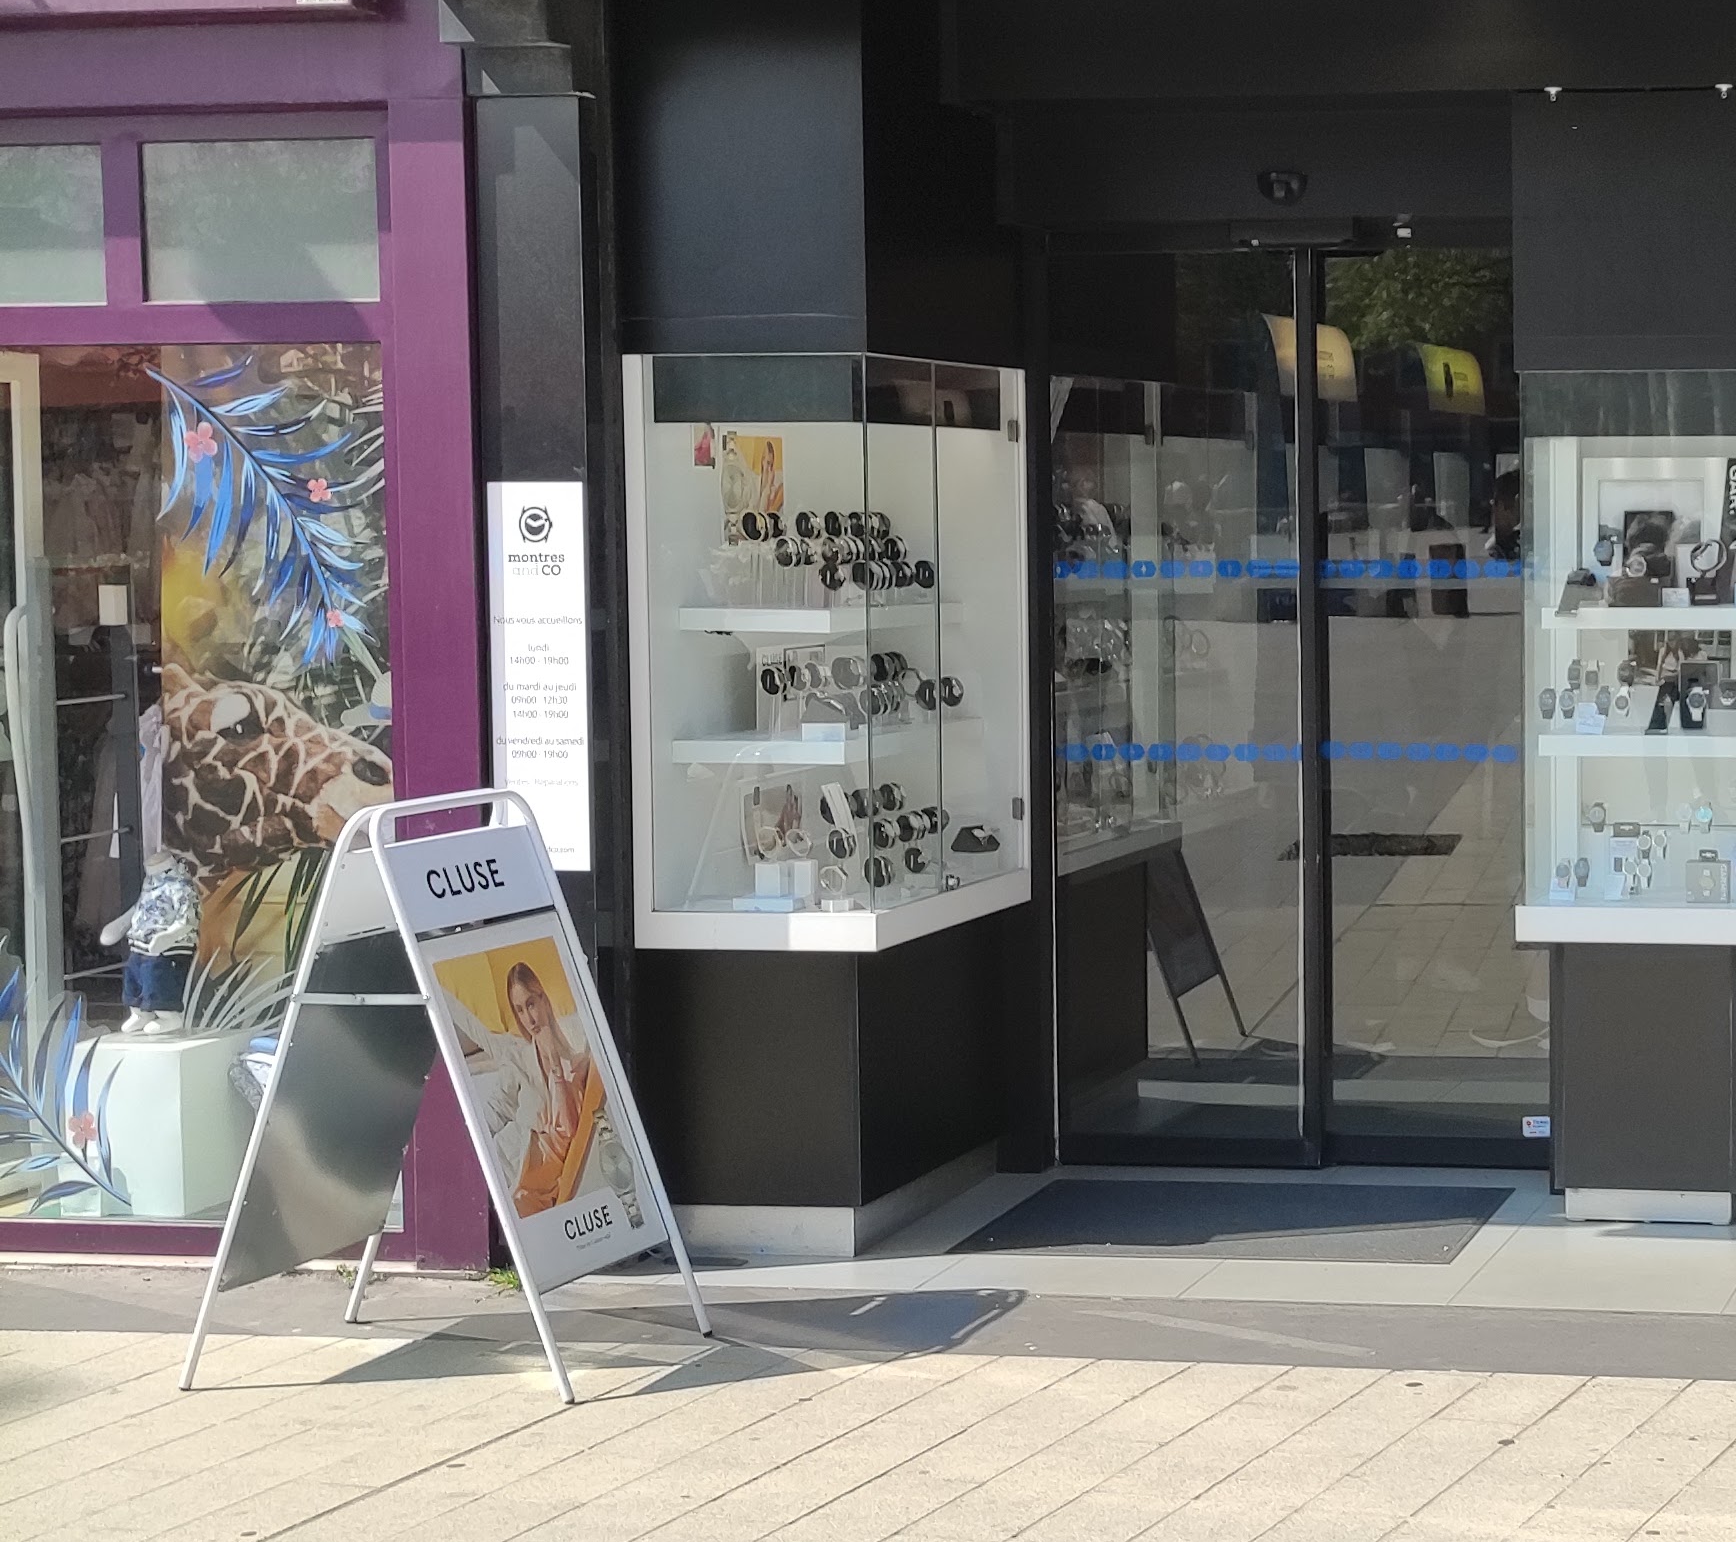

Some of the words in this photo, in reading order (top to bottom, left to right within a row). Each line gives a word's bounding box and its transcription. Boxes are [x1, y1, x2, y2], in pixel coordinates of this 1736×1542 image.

[507, 552, 565, 563] montres
[542, 564, 561, 576] CO
[426, 859, 505, 899] CLUSE
[564, 1205, 613, 1240] CLUSE
